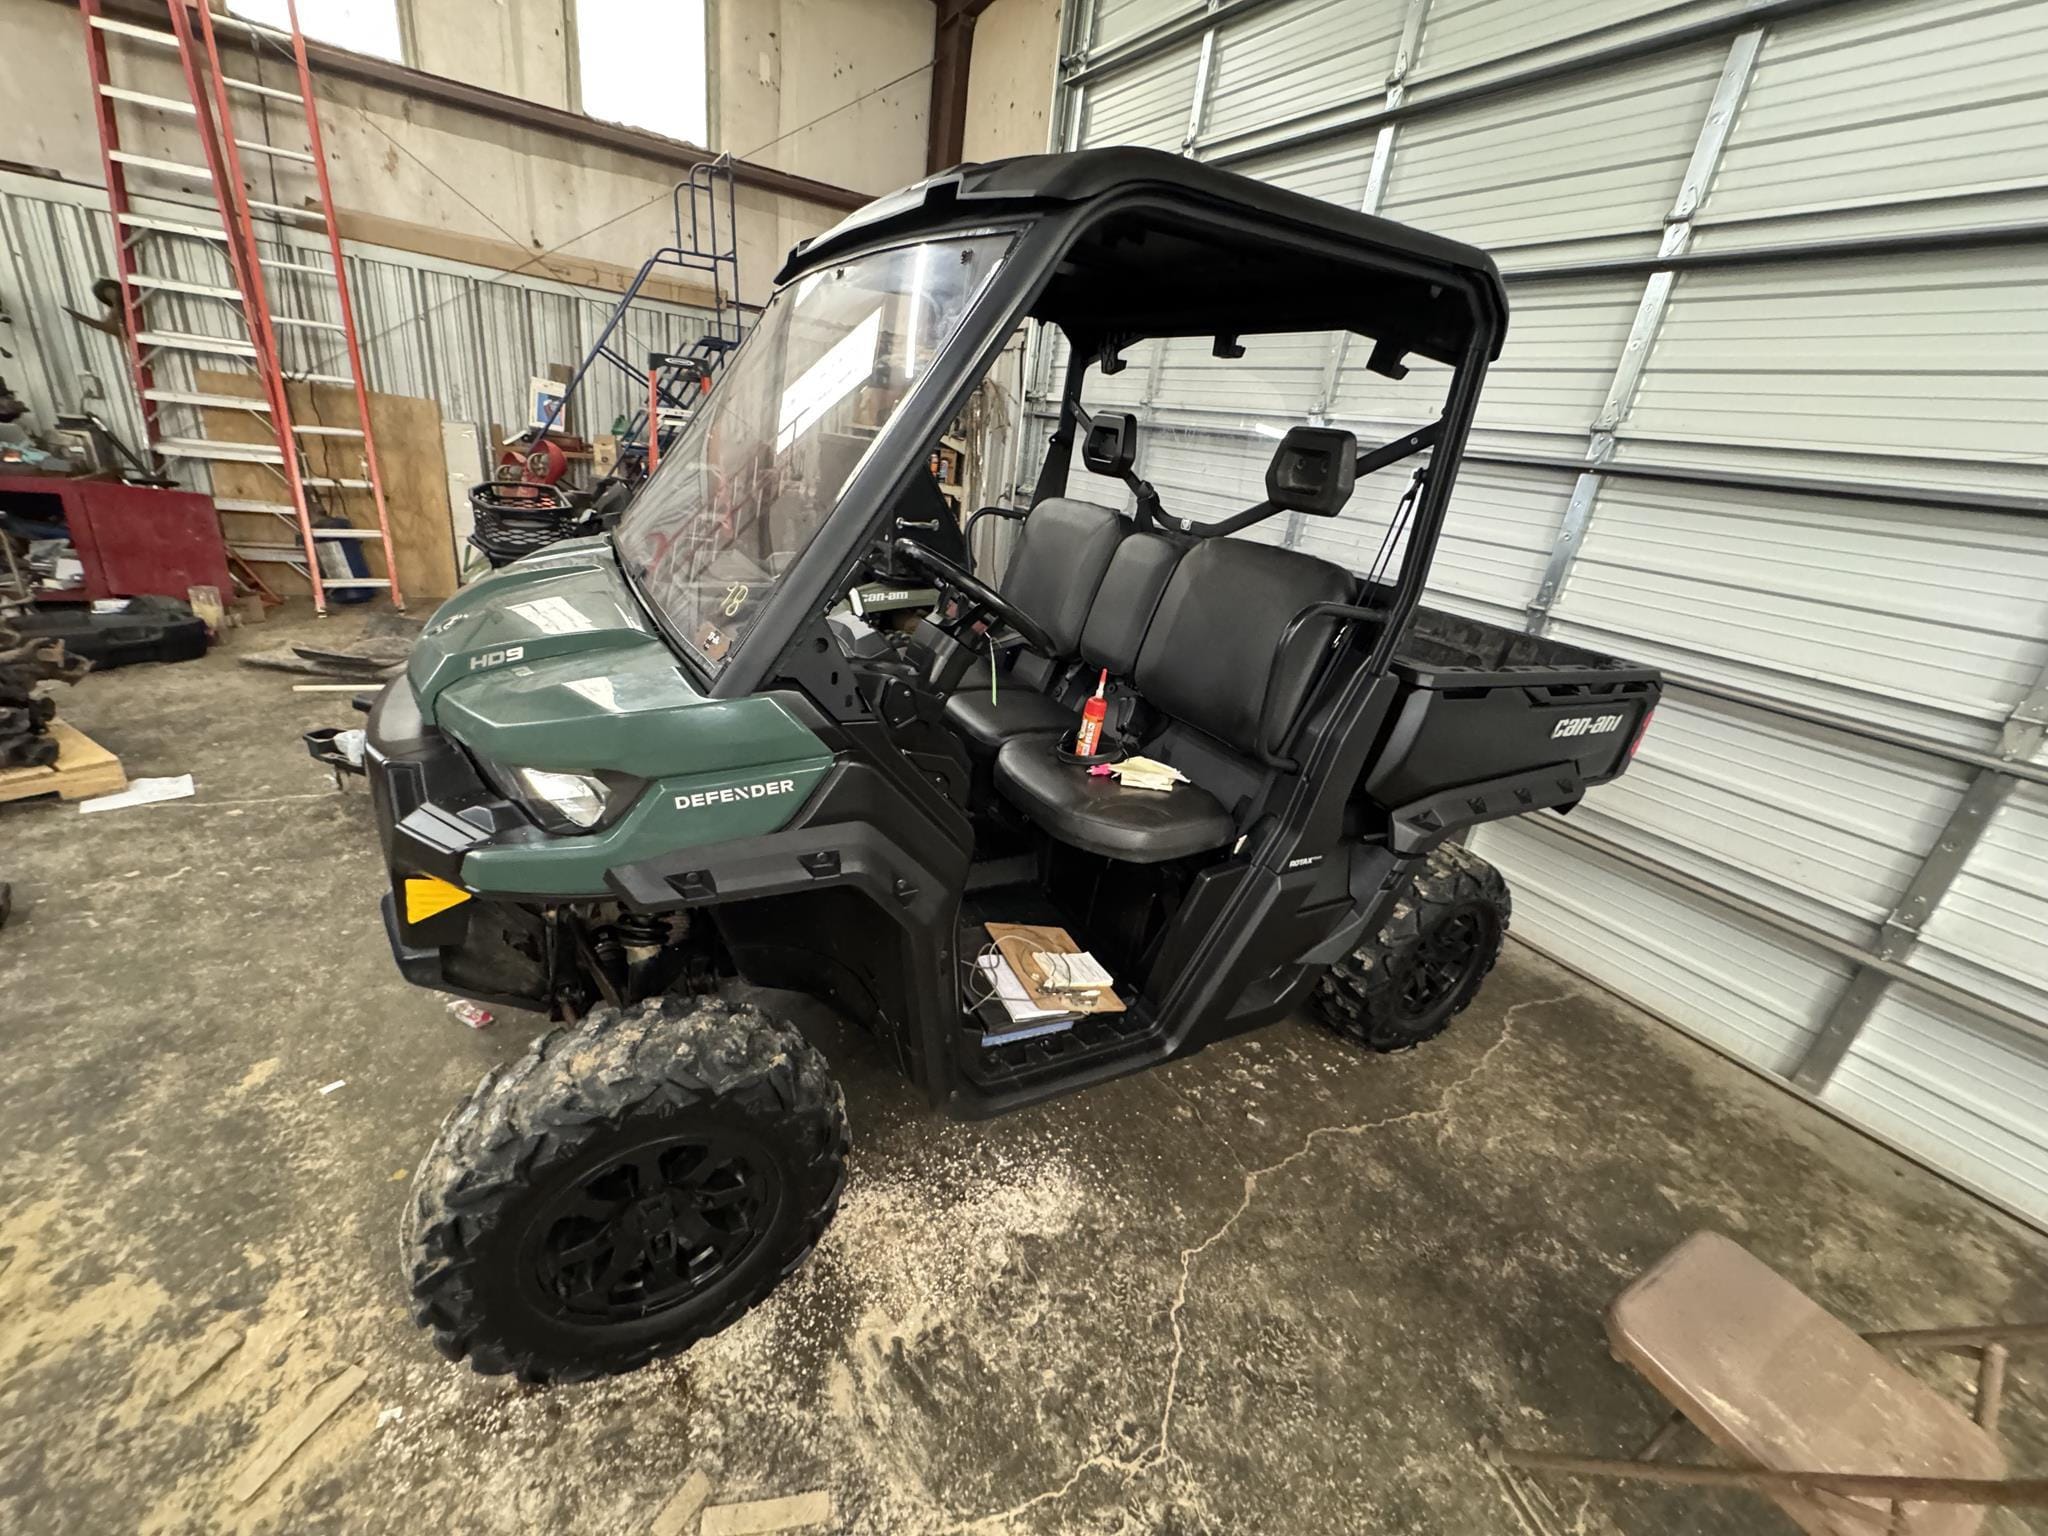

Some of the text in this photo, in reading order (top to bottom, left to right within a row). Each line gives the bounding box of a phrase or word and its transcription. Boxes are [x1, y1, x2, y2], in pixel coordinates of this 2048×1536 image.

[469, 646, 524, 670] HD9
[1550, 713, 1624, 740] can-am
[674, 779, 795, 810] DEFENDER
